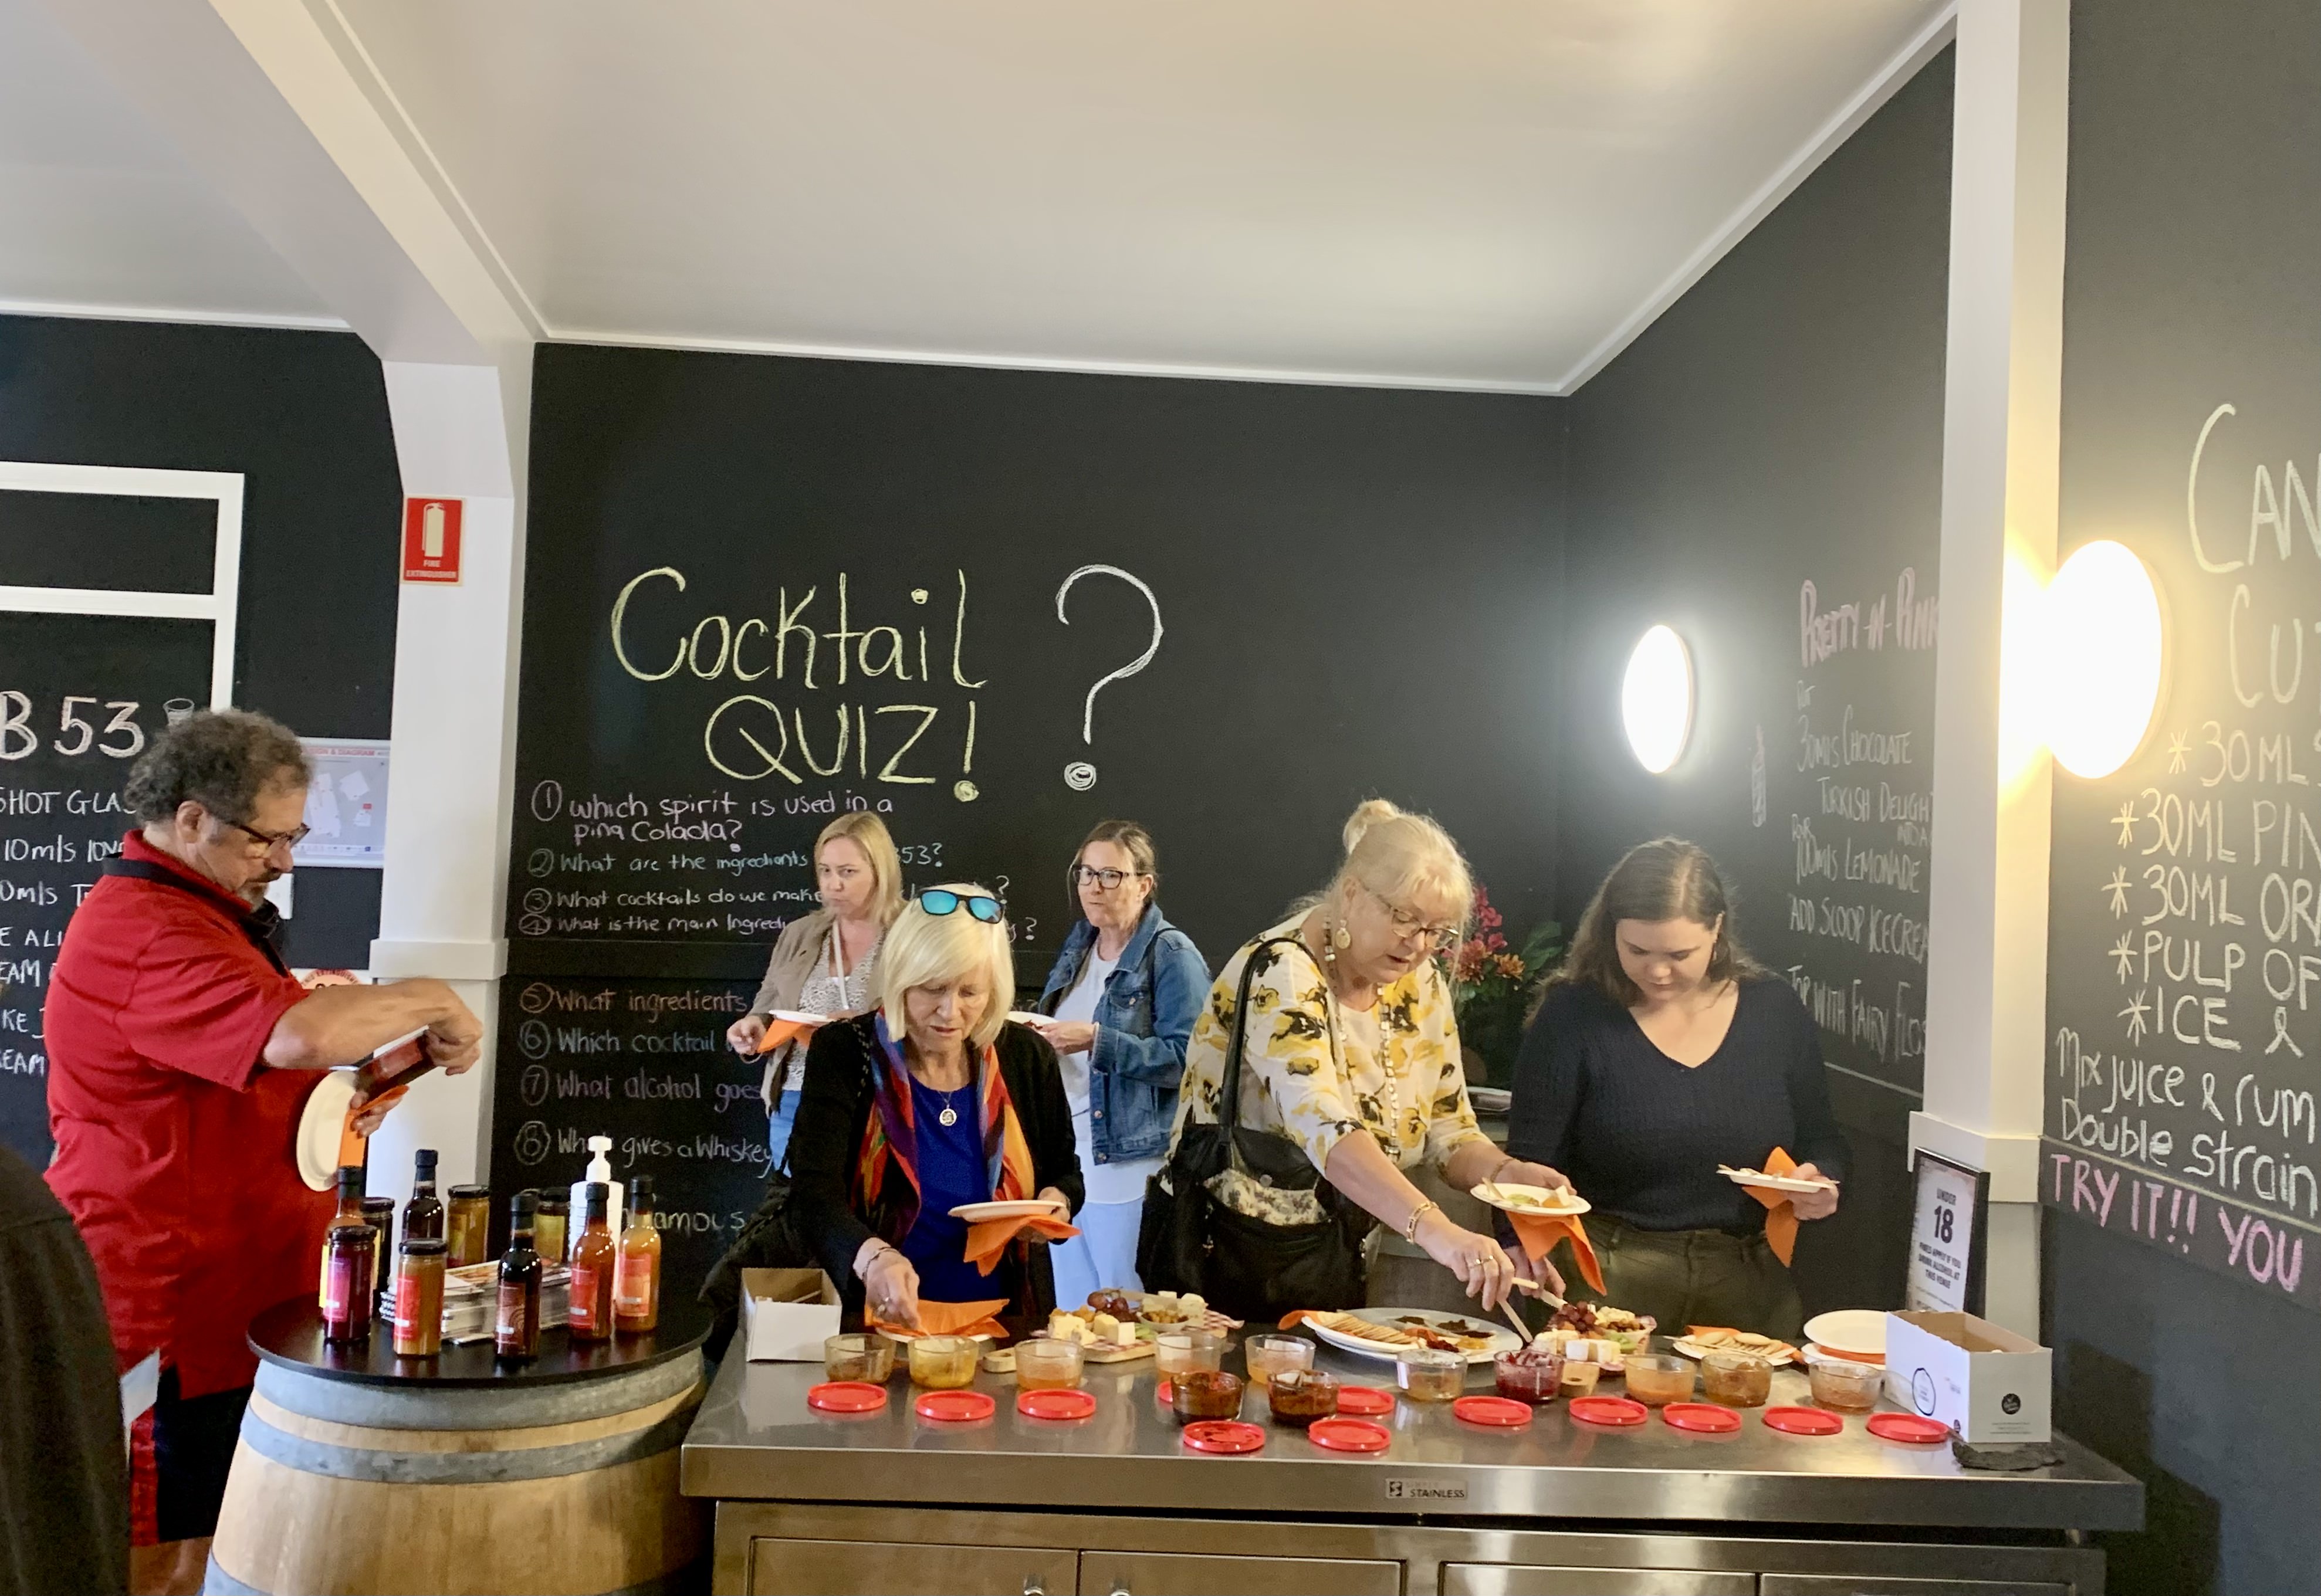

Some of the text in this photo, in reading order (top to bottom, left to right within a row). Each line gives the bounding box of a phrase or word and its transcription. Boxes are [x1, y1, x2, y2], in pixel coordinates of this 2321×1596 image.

[611, 567, 988, 689] Cocktail
[1055, 564, 1164, 791] ?
[54, 696, 145, 758] 53
[706, 694, 981, 802] QUIZ!
[1843, 704, 1912, 765] CHOCOLATE
[2200, 721, 2309, 787] 30ML
[659, 789, 738, 824] spirit
[752, 798, 775, 816] is
[784, 791, 835, 814] used
[845, 789, 868, 812] in
[877, 799, 893, 813] a
[2141, 788, 2237, 862] 30ML
[560, 853, 616, 872] What
[630, 858, 660, 871] are
[668, 854, 706, 870] the
[631, 820, 743, 852] Colada?
[1845, 837, 1921, 893] LEMONADE
[557, 890, 610, 908] What
[617, 888, 701, 906] cocktails
[708, 888, 735, 903] do
[739, 892, 767, 903] we
[1819, 897, 1865, 944] SCOOP
[2141, 865, 2246, 926] 30ML
[558, 916, 602, 932] What
[608, 917, 622, 931] is
[623, 916, 660, 931] the
[668, 917, 719, 933] main
[2143, 930, 2246, 992] PULP
[557, 989, 616, 1011] What
[628, 990, 749, 1023] ingredients
[2157, 986, 2241, 1051] ICE
[558, 1027, 619, 1053] Which
[631, 1030, 716, 1053] cocktail
[557, 1071, 614, 1100] What
[624, 1067, 702, 1100] alcohol
[2235, 1074, 2315, 1144] rum
[622, 1136, 672, 1168] gives
[677, 1144, 693, 1158] a
[695, 1134, 774, 1179] Whiskey
[2062, 1096, 2173, 1167] Double
[650, 1204, 746, 1234] amous
[1934, 1205, 1954, 1243] 18
[2051, 1154, 2303, 1292] TRY IT!! YOU
[1410, 1489, 1465, 1497] STAINLESS
